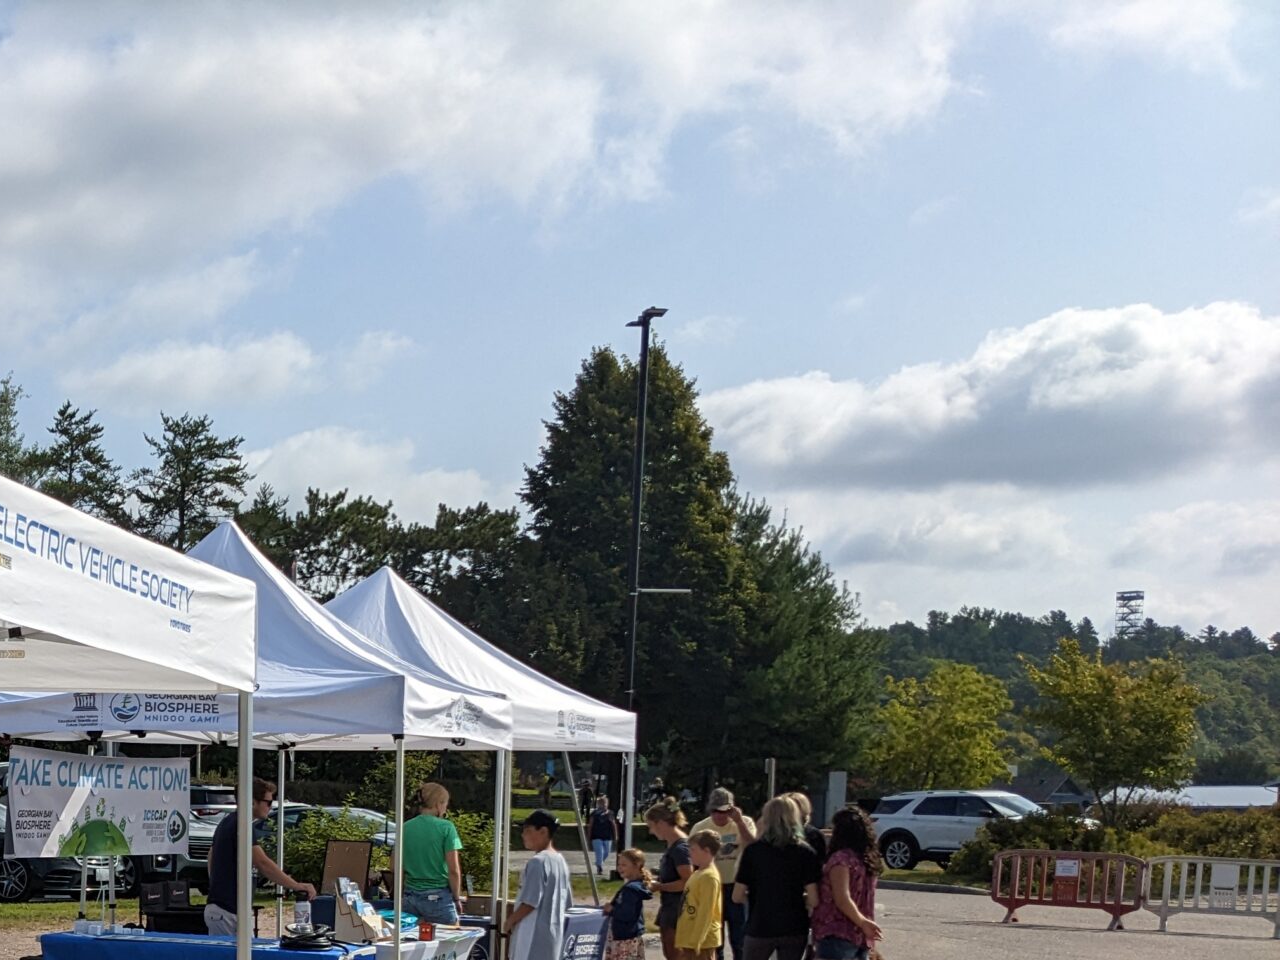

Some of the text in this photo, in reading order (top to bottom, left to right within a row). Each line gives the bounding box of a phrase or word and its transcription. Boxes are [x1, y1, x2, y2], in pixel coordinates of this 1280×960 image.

[78, 541, 139, 595] VEHICLE
[139, 568, 195, 614] SOCIETY
[144, 701, 220, 714] BIOSPHERE
[144, 715, 185, 723] MNIDOO
[9, 757, 189, 792] TAKE CLIMATE ACTION!
[17, 809, 54, 818] GEORGIAN BAY
[143, 809, 168, 821] ICECAP
[15, 820, 52, 830] BIOSPHERE
